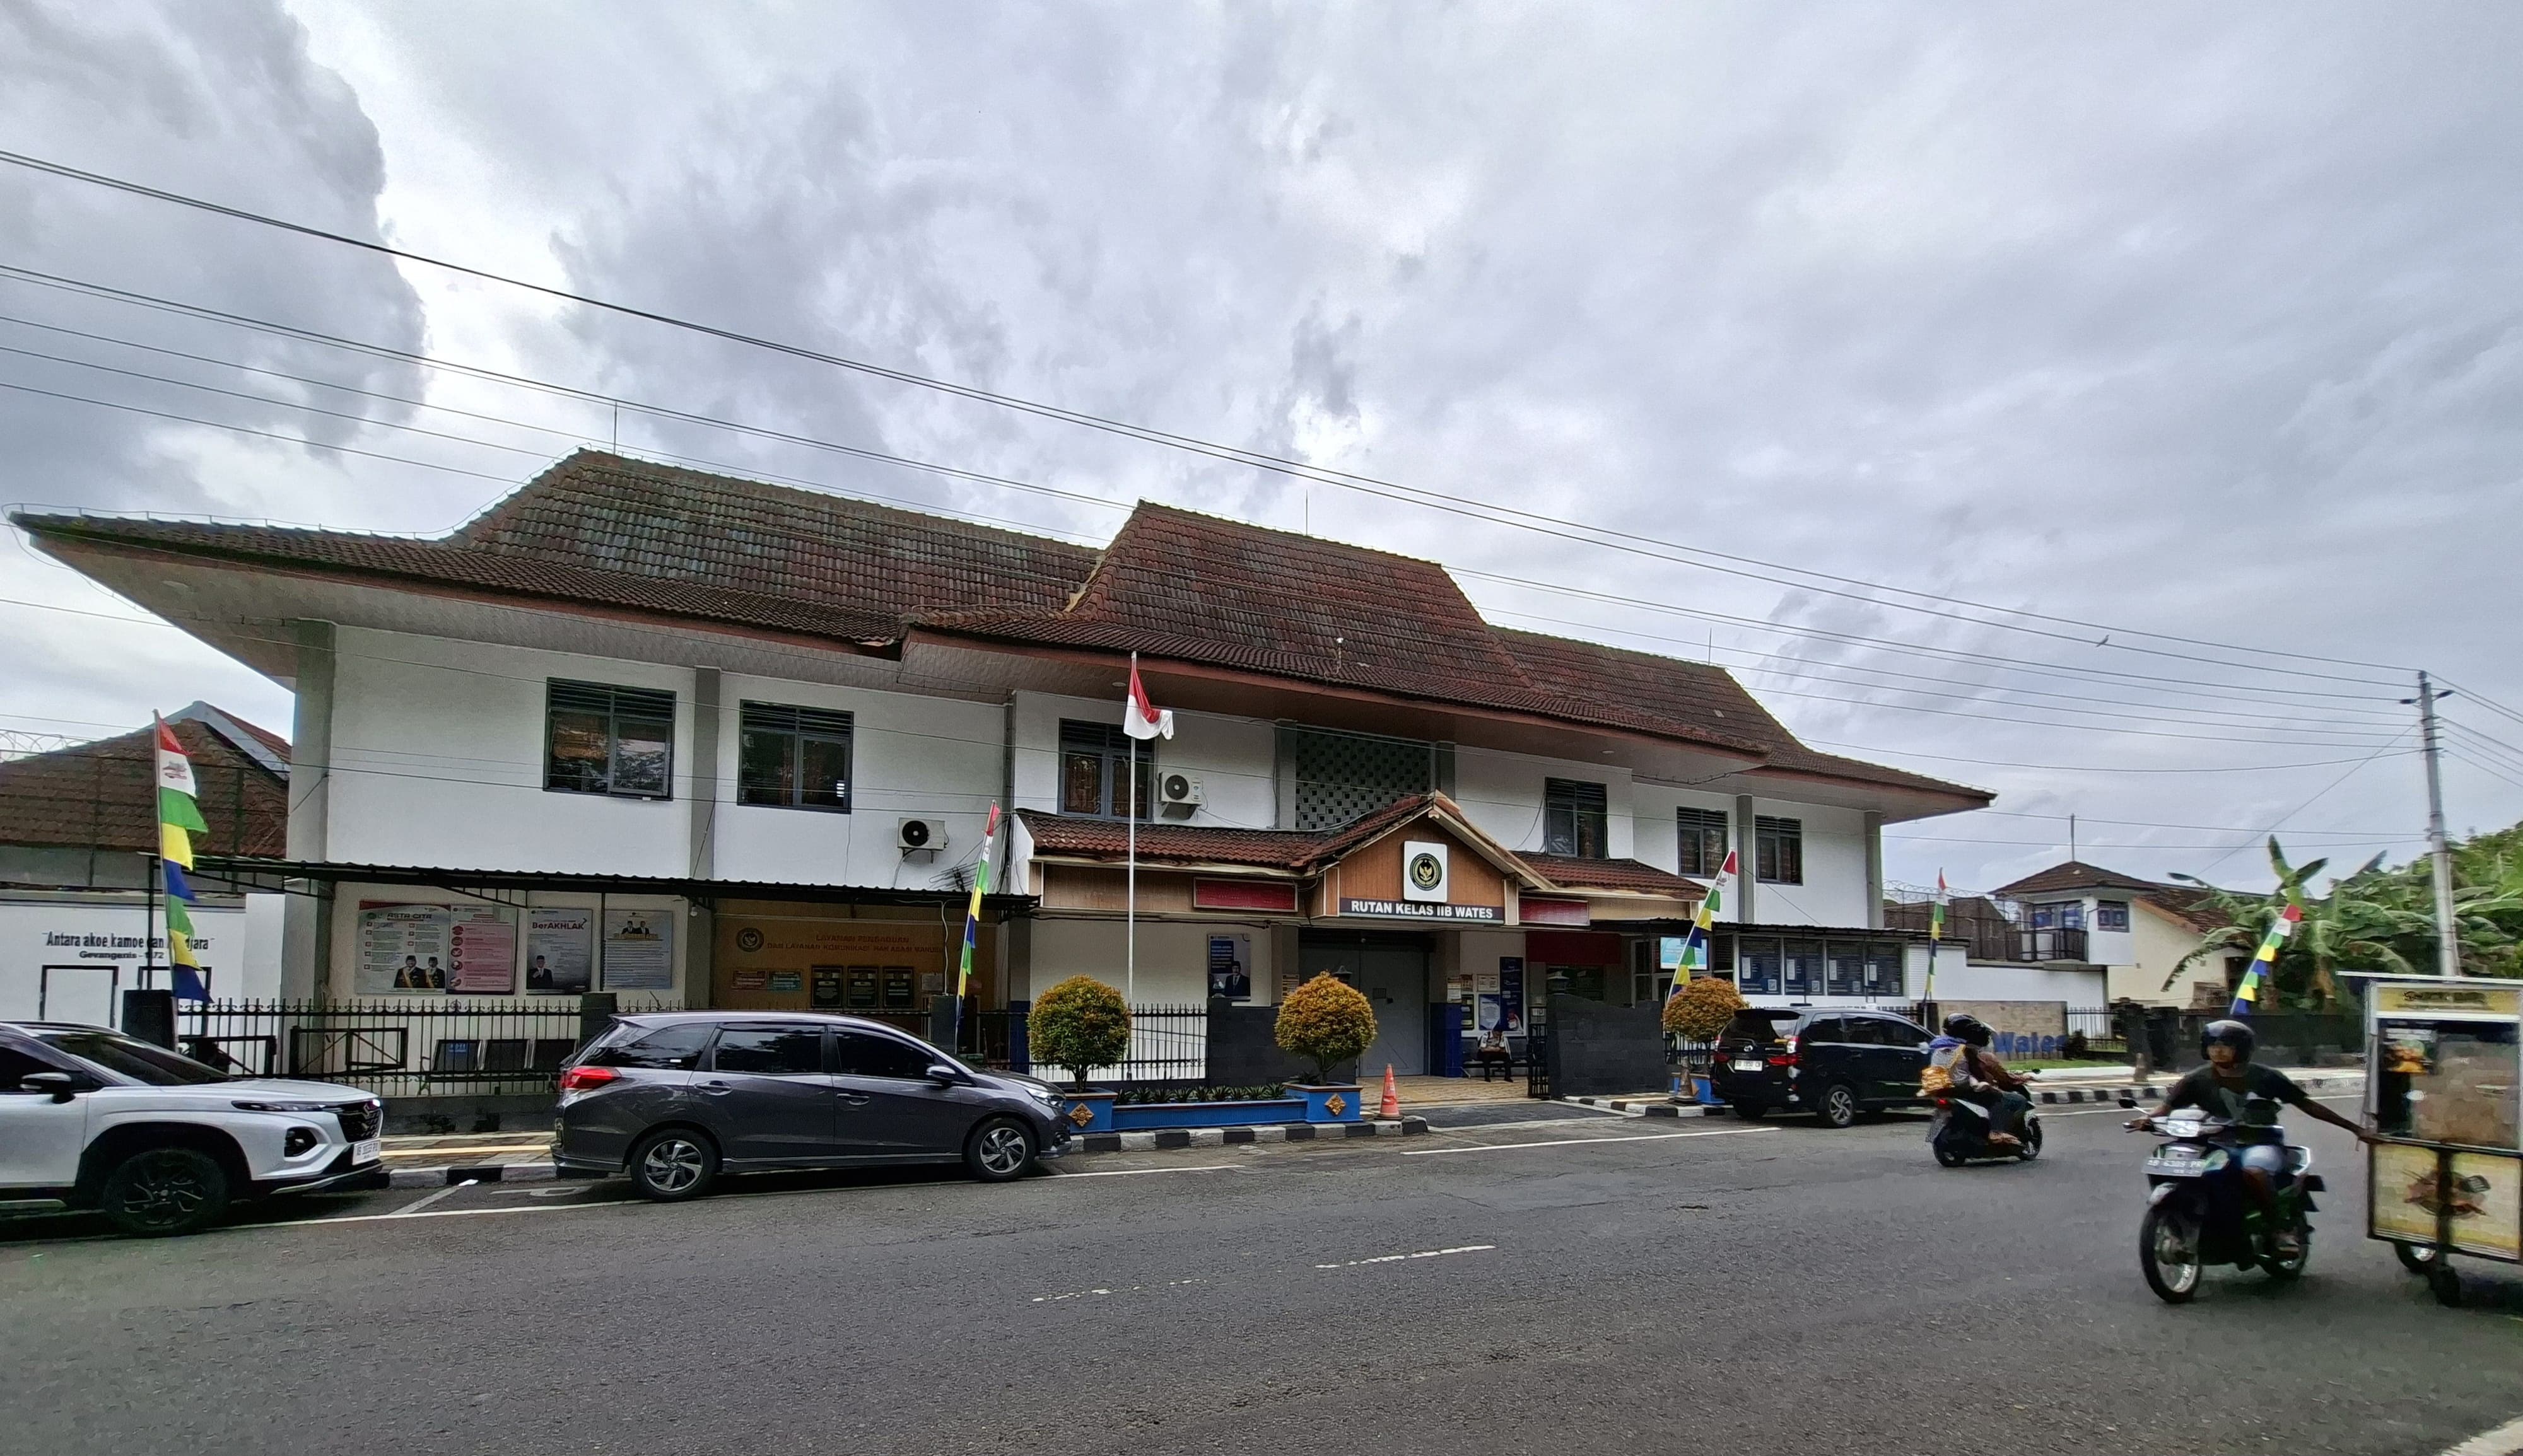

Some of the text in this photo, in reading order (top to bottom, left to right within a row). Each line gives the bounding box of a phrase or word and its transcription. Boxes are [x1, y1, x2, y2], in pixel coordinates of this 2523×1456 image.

[1351, 900, 1493, 918] RUTAN KELAS IIB WATES
[532, 921, 585, 930] BerAKHLAK
[111, 933, 144, 948] kamoe
[79, 950, 137, 960] Gevangenis
